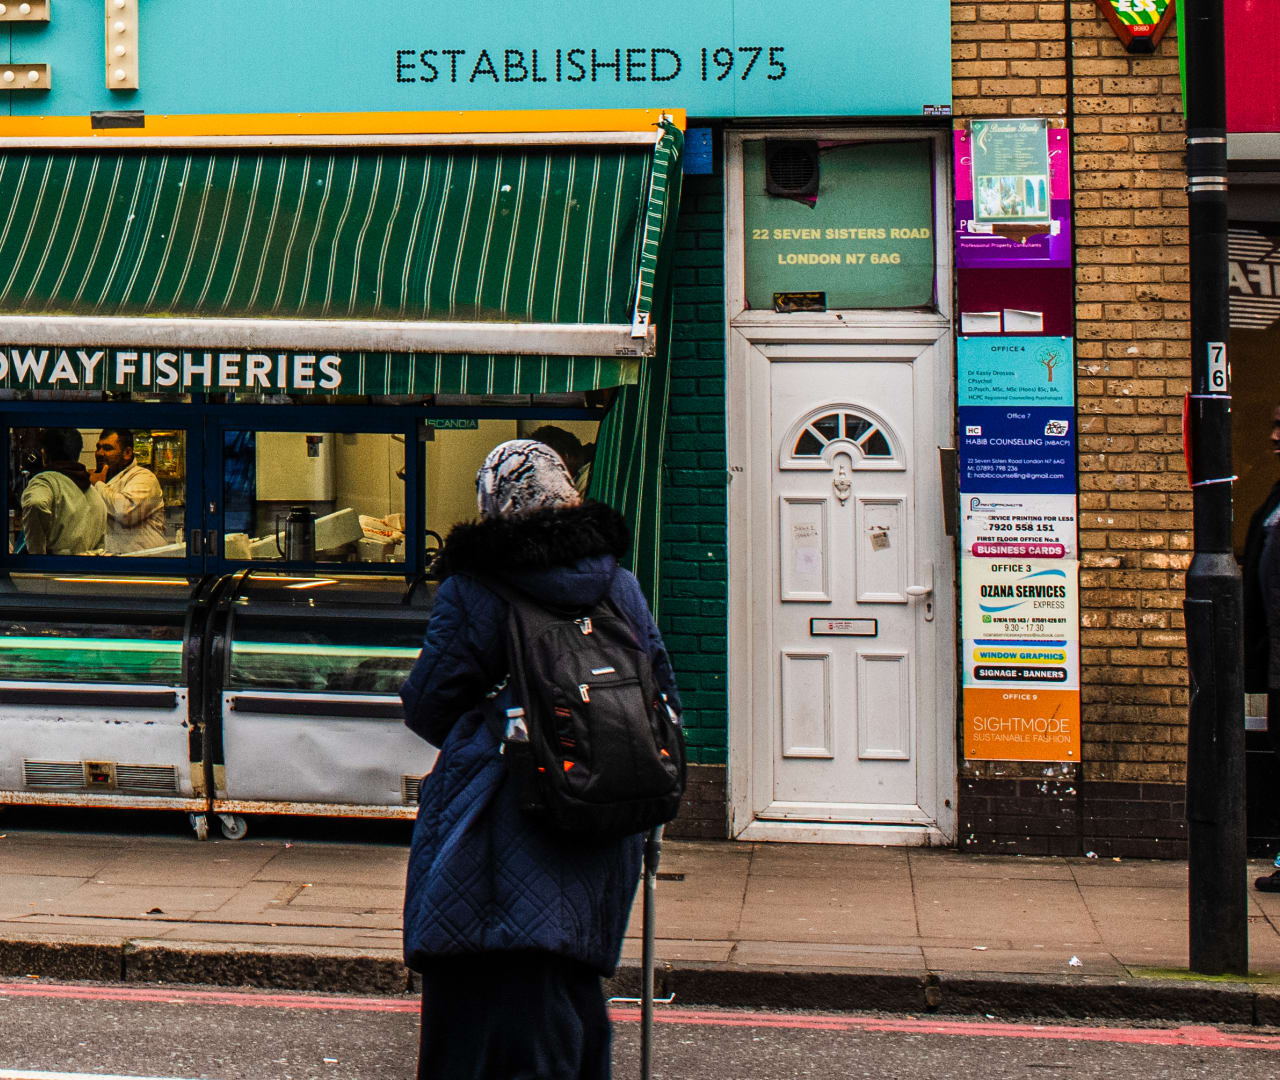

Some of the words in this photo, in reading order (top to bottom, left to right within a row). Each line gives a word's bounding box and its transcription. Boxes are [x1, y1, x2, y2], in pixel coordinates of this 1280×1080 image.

[395, 47, 682, 84] ESTABLISHED
[700, 46, 787, 81] 1975
[752, 228, 770, 240] 22
[773, 228, 822, 240] SEVEN
[824, 228, 887, 240] SISTERS
[890, 228, 930, 240] ROAD
[777, 253, 842, 265] LONDON
[845, 253, 866, 264] N7
[869, 253, 902, 265] 6AG
[115, 350, 342, 389] FISHERIES
[989, 438, 1043, 446] COUNSELLING
[1015, 523, 1034, 531] 558
[977, 546, 1026, 554] BUSINESS
[1028, 546, 1062, 555] CARDS
[991, 564, 1024, 572] OFFICE
[1025, 564, 1032, 572] 3
[980, 584, 1014, 598] OZANA
[1015, 585, 1066, 598] SERVICES
[1033, 600, 1065, 609] EXPRESS
[1019, 652, 1064, 661] GRAPHICS
[979, 669, 1017, 677] SIGNAGE
[1023, 670, 1064, 678] BANNERS
[973, 716, 1070, 733] SIGHTMODE
[973, 734, 1030, 743] SUSTAINABLE
[1033, 734, 1071, 743] FASHION
